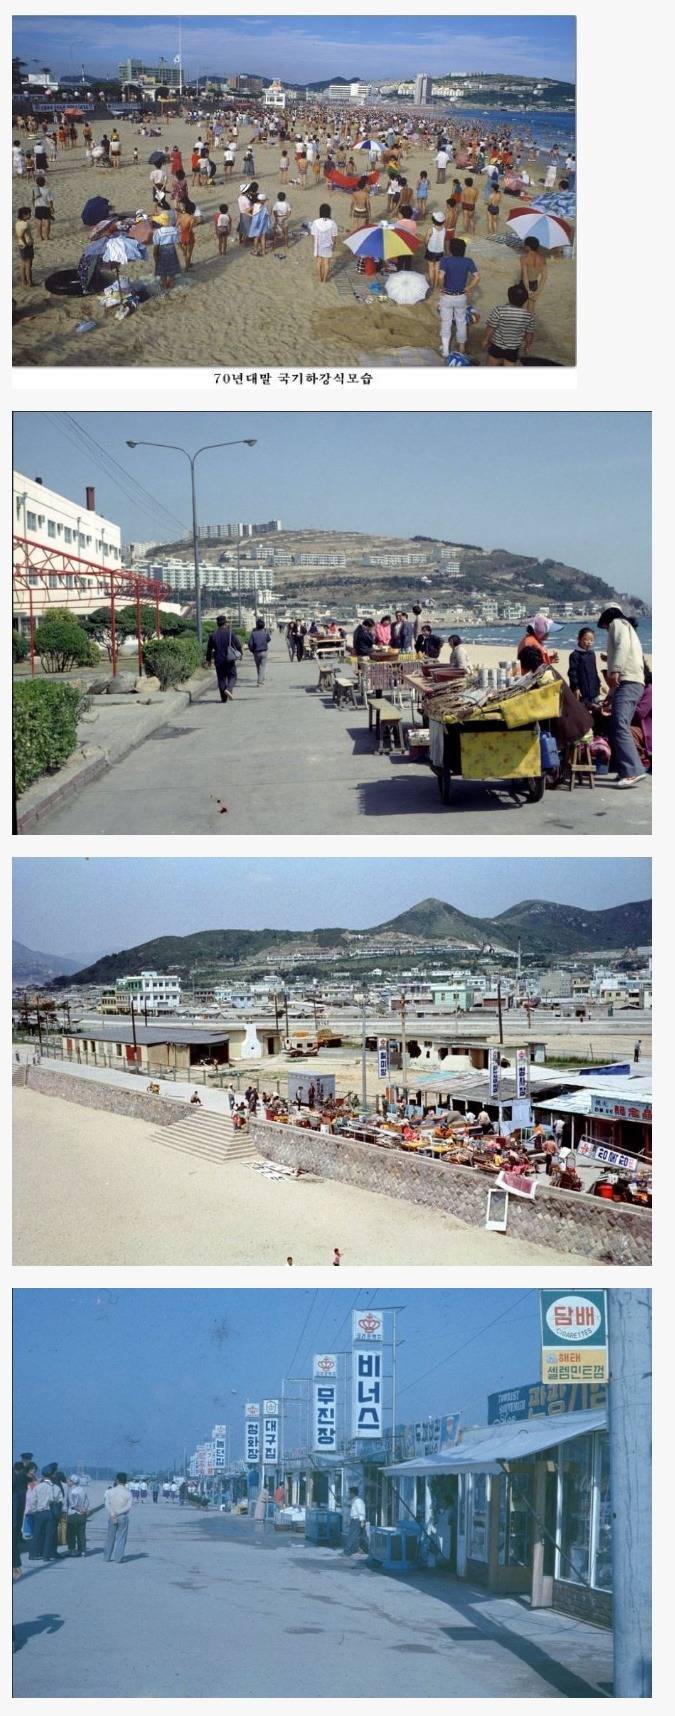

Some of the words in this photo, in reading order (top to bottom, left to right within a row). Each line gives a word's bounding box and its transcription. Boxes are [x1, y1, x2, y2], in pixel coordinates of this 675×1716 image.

[554, 1306, 595, 1327] 담배
[556, 1327, 593, 1339] CIGARETTES
[558, 1352, 581, 1363] 해태
[358, 1354, 380, 1430] 비너스
[317, 1387, 335, 1445] 무진장
[265, 1420, 277, 1460] 대구집
